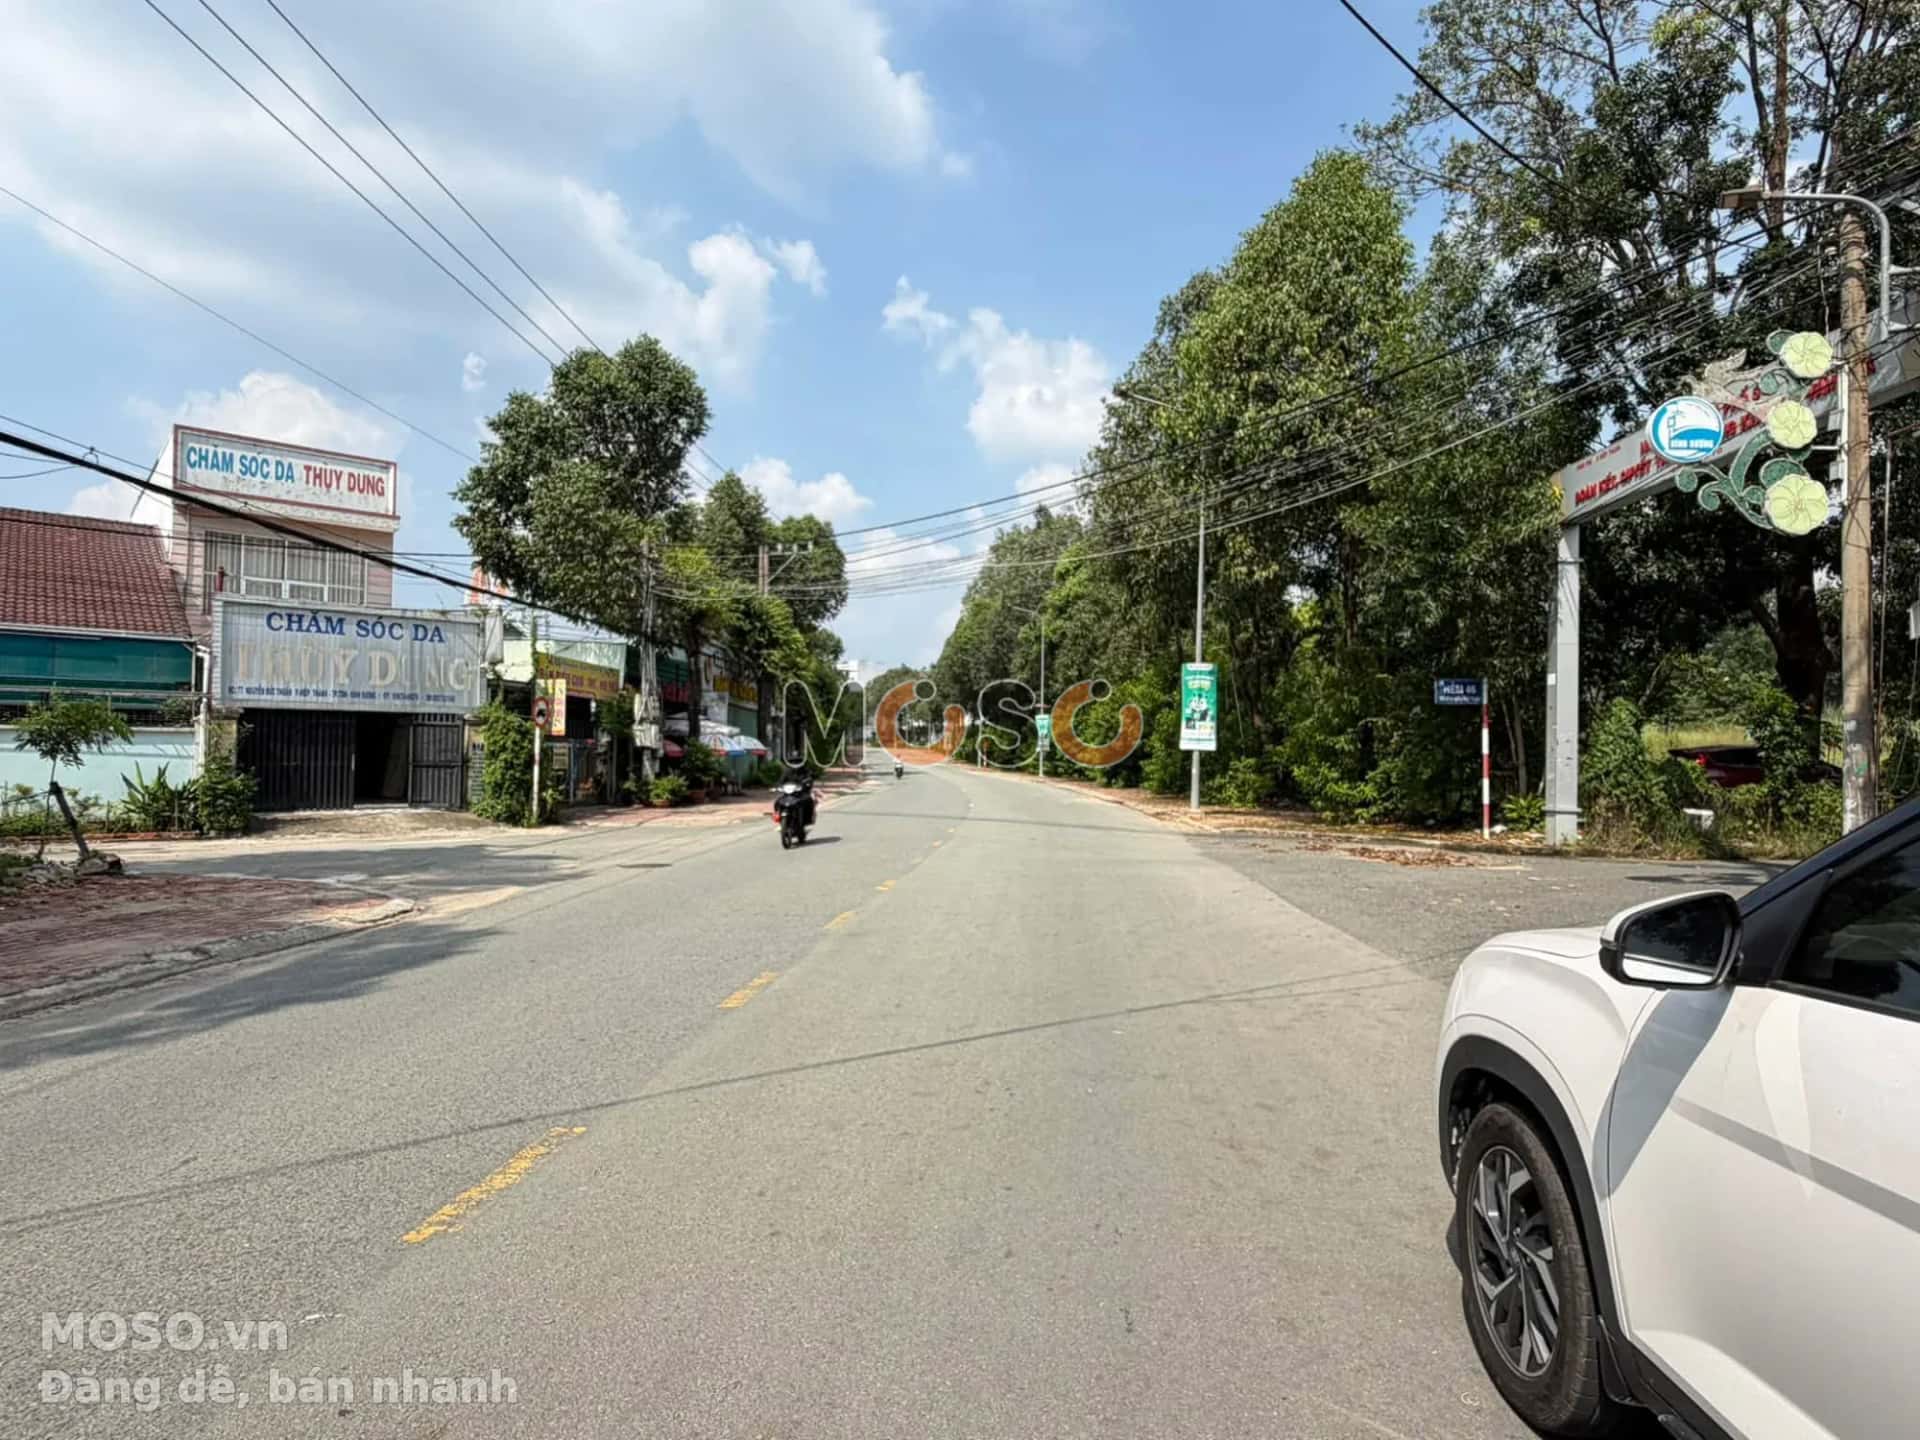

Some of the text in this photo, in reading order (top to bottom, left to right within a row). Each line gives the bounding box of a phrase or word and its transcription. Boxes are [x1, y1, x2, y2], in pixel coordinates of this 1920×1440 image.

[187, 444, 234, 474] CHĂM
[274, 460, 295, 484] DA
[348, 473, 385, 497] DUNG
[266, 609, 445, 643] CHĂM SÓC DA
